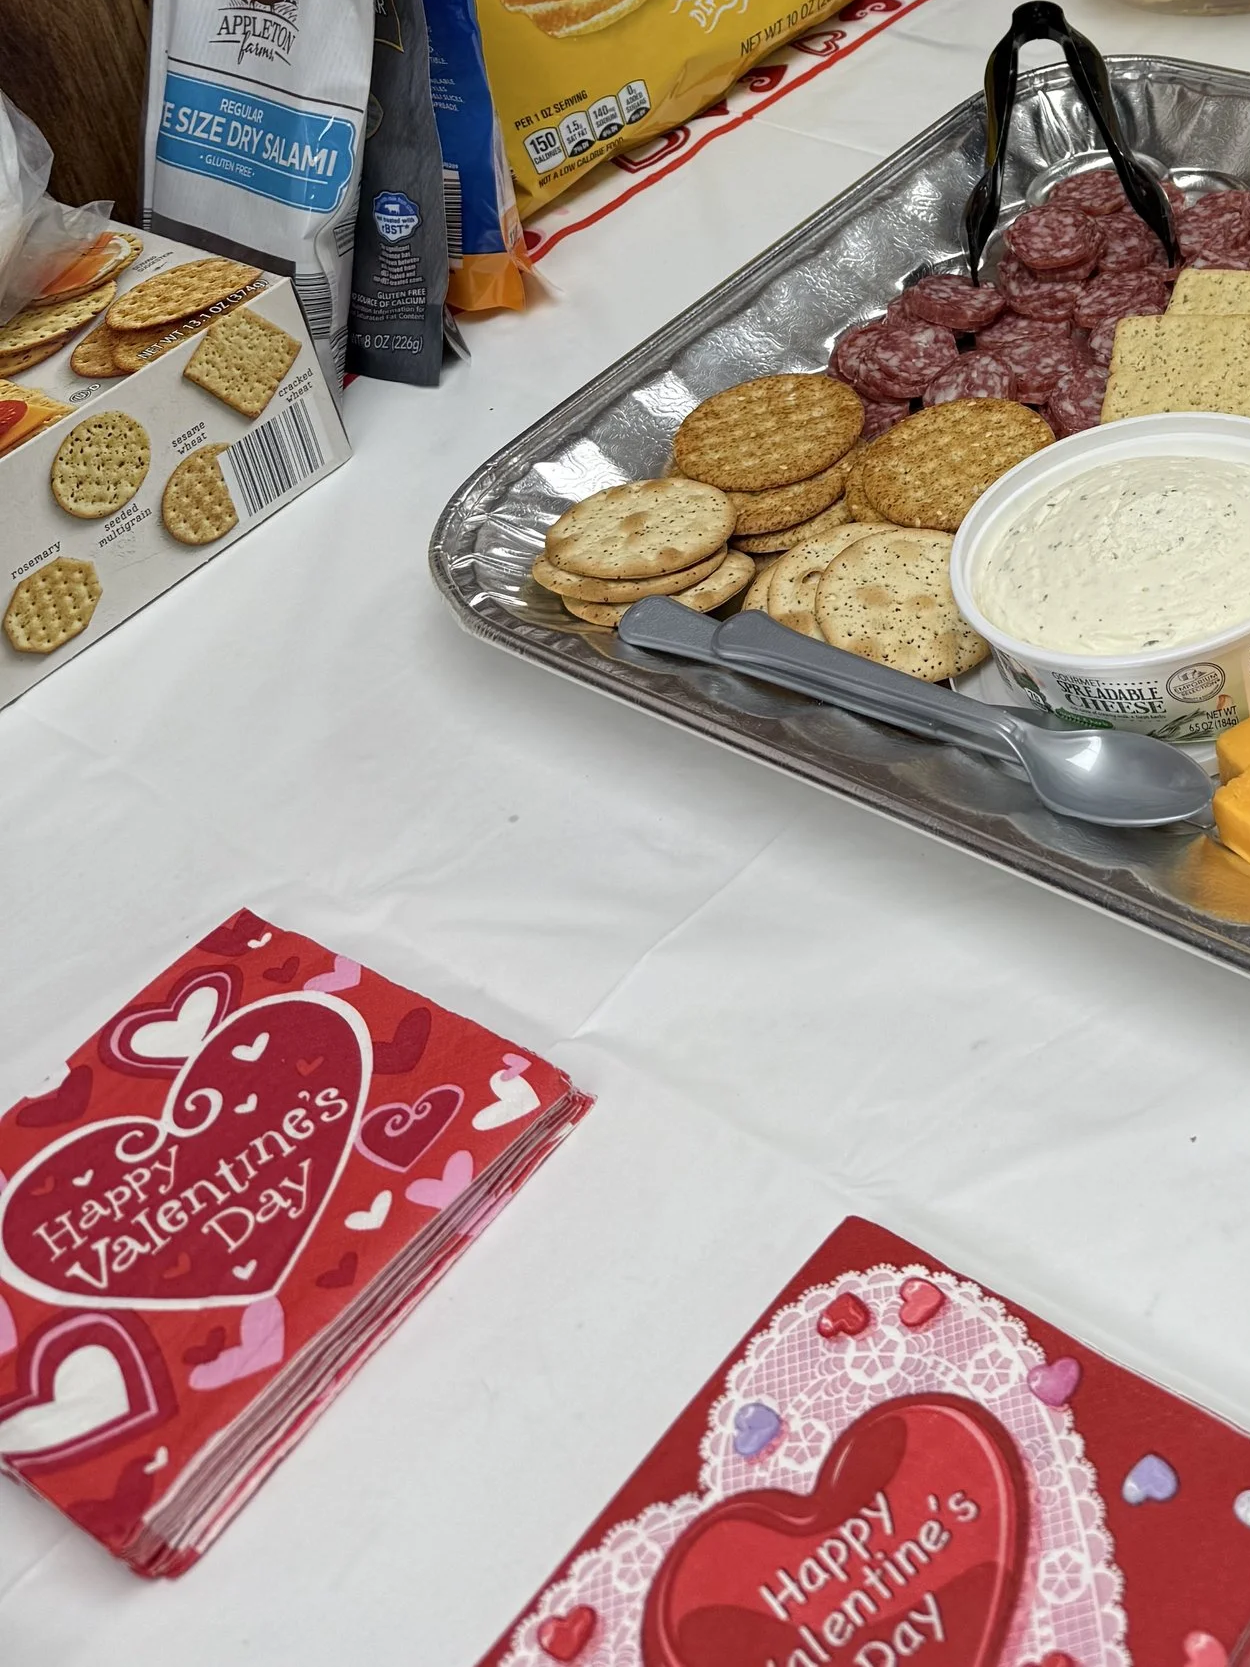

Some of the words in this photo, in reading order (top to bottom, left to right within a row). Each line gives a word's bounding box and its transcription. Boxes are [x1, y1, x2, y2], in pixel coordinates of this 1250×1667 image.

[217, 15, 296, 54] APPLETON
[740, 31, 764, 58] NET
[764, 17, 785, 42] WT
[786, 11, 801, 29] 10
[800, 0, 817, 19] OZ
[237, 30, 274, 65] farms
[220, 98, 264, 123] REGULAR
[515, 114, 534, 131] PER
[541, 107, 553, 120] OZ
[553, 90, 588, 113] SERVING
[625, 92, 643, 106] ADDED
[595, 112, 618, 129] SODIUM
[175, 107, 226, 143] SIZE
[227, 122, 264, 155] DRY
[262, 133, 338, 177] SALAMI
[529, 131, 557, 155] 150
[566, 133, 578, 145] SAT
[578, 127, 588, 140] FAT
[205, 154, 234, 172] GLUTEN
[235, 165, 253, 178] FREE
[534, 146, 562, 165] CALORIES
[538, 174, 552, 188] NOT
[559, 162, 577, 178] LOW
[576, 147, 605, 169] CALORIE
[357, 294, 378, 307] SOURCE
[379, 300, 390, 308] OF
[391, 296, 426, 307] CALCIUM
[378, 291, 406, 300] GLUTEN
[408, 288, 426, 297] FREE
[138, 342, 163, 359] NET
[160, 330, 184, 344] WT
[183, 313, 211, 330] 13.1
[209, 301, 229, 314] OZ
[226, 279, 269, 303] (374g)
[364, 335, 371, 348] 8
[374, 335, 390, 349] OZ
[391, 335, 423, 354] (226g)
[278, 368, 314, 397] cracked
[286, 381, 313, 403] wheat
[171, 421, 206, 448] sesame
[177, 431, 208, 455] wheat
[99, 507, 153, 548] multigrain
[104, 504, 139, 531] seeded
[11, 541, 62, 580] rosemary
[1052, 671, 1101, 687] GOURMET
[1057, 680, 1163, 701] SPREADABLE
[1173, 672, 1218, 694] EMPORIUM
[1065, 693, 1166, 714] CHEESE
[1206, 709, 1222, 720] NET
[1222, 706, 1236, 716] WT
[1202, 721, 1213, 731] OZ
[64, 1085, 350, 1291] Valentine's
[33, 1143, 180, 1261] Happy
[202, 1157, 317, 1254] Day
[759, 1491, 895, 1621] Happy
[766, 1489, 981, 1667] alentine's
